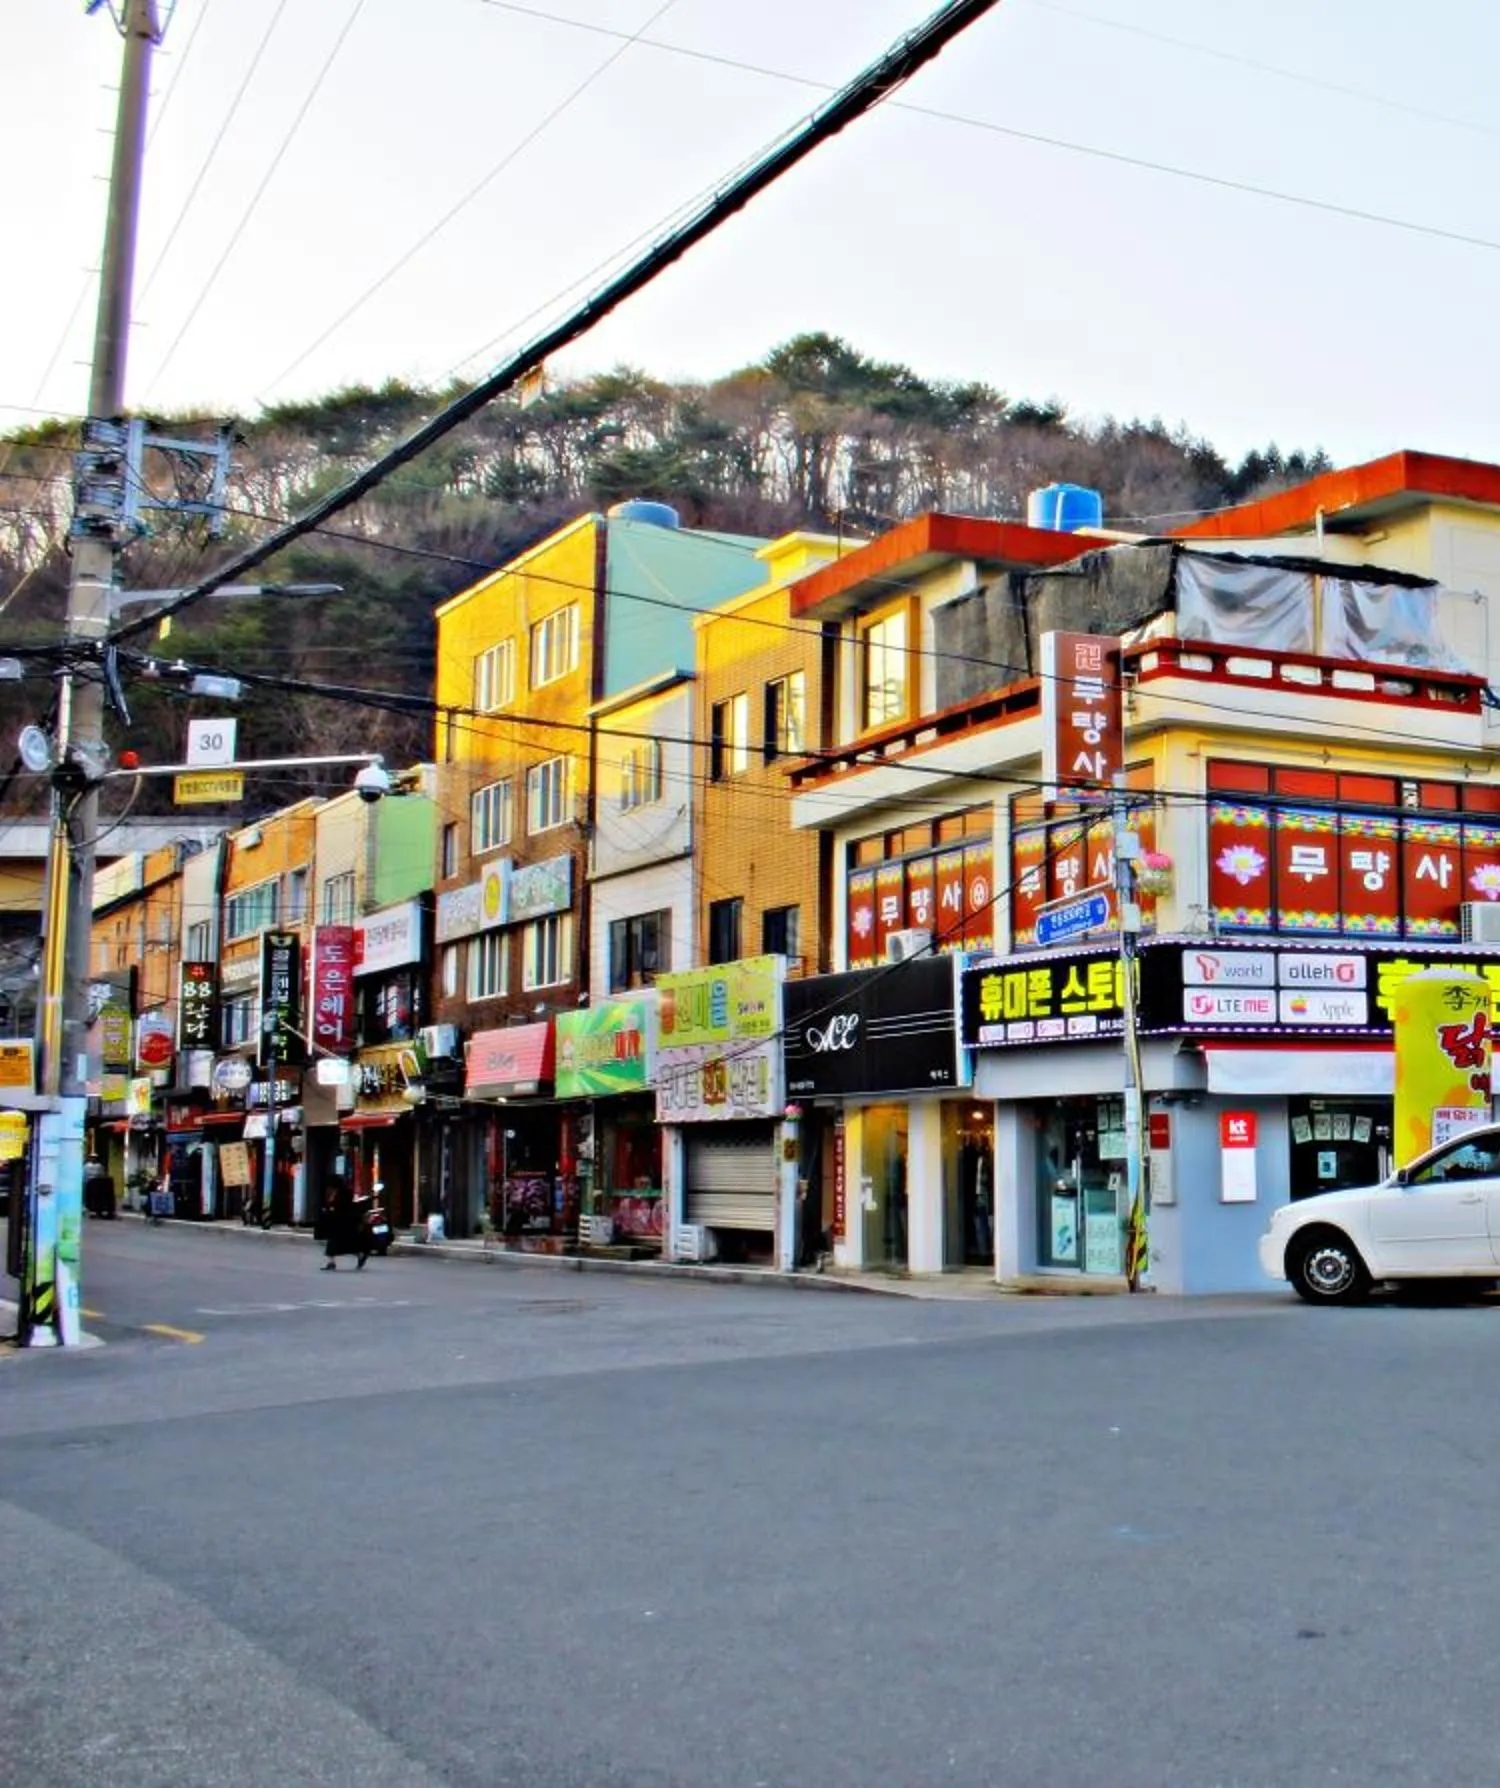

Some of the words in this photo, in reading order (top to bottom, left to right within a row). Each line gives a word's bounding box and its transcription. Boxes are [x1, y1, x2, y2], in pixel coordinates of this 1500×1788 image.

[200, 733, 223, 751] 30
[1072, 675, 1108, 779] 무량사
[1020, 850, 1115, 900] 무량사
[1289, 845, 1452, 891] 무량사
[881, 882, 962, 926] 무량사
[1224, 963, 1264, 979] world
[1289, 961, 1334, 978] olleh
[980, 973, 1052, 1021] 휴대폰
[1216, 999, 1242, 1014] LTE
[1243, 999, 1269, 1013] ME
[1319, 999, 1355, 1021] Apple
[806, 1013, 859, 1053] ACE
[1228, 1119, 1248, 1137] kt
